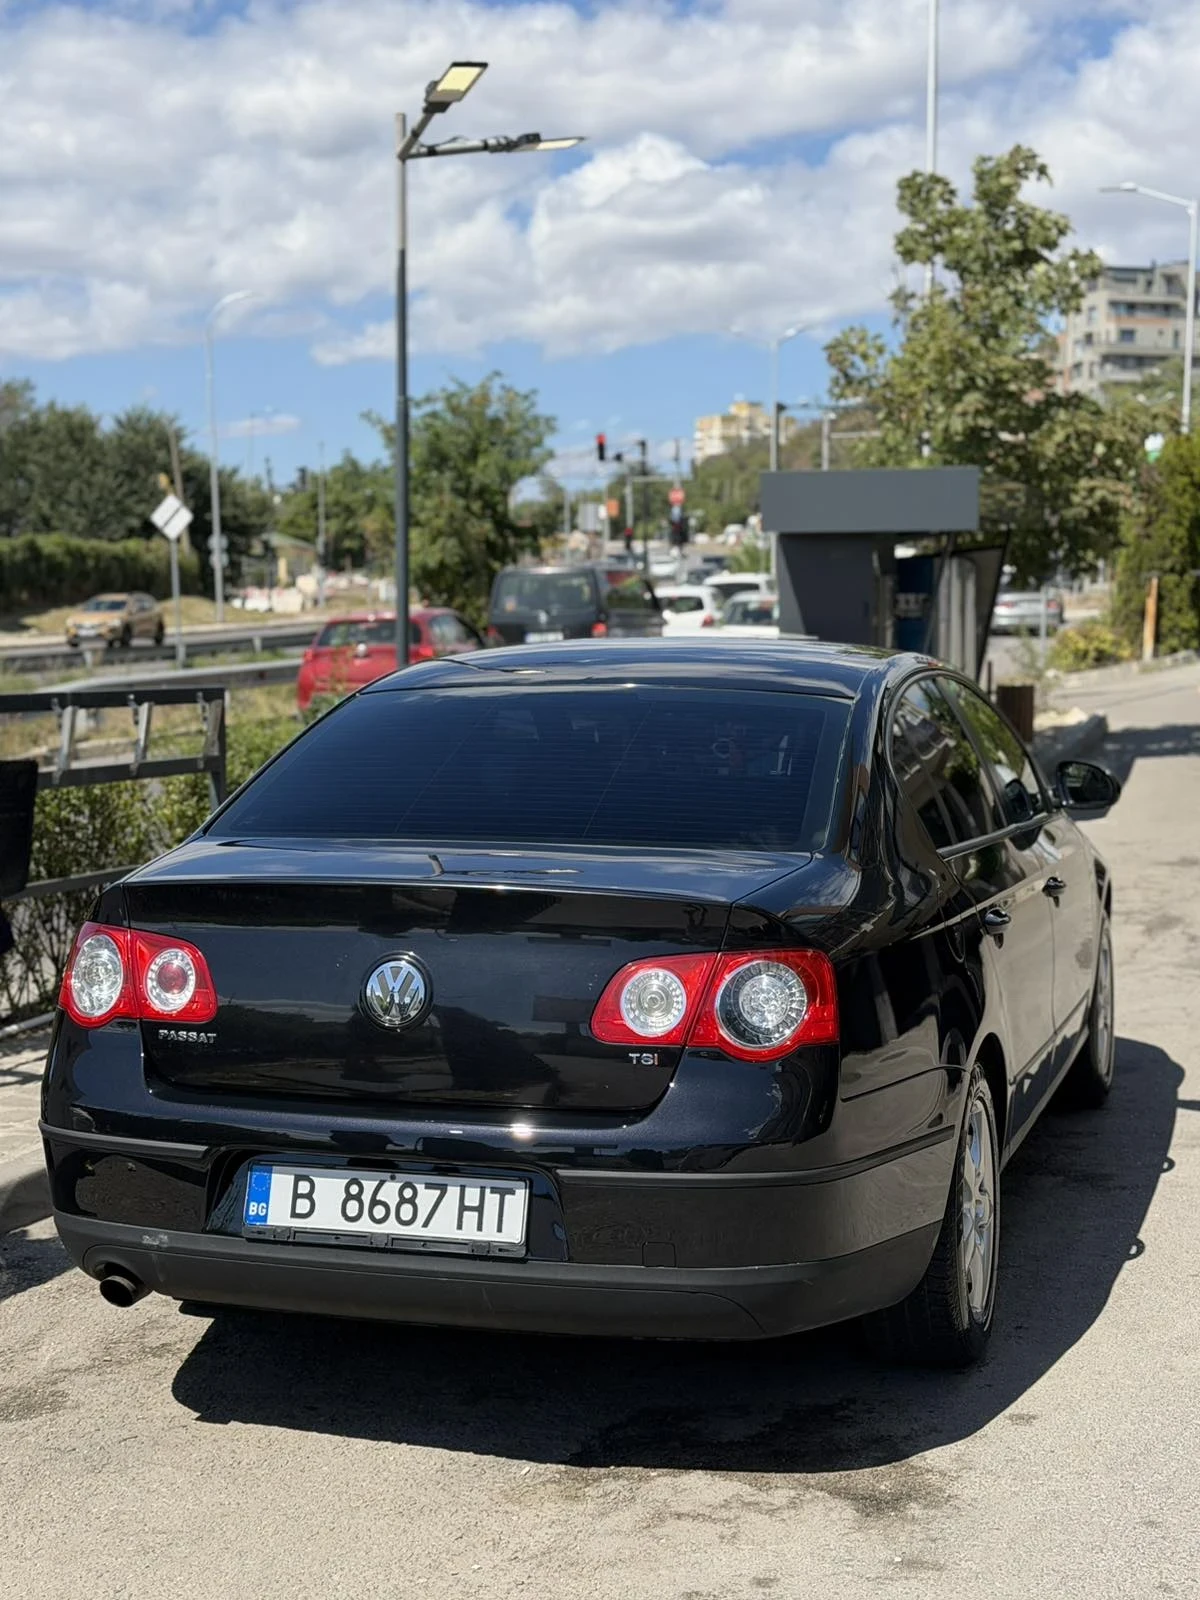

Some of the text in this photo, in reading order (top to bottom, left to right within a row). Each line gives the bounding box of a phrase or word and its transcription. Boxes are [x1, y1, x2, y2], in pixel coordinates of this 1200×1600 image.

[158, 1029, 217, 1044] PASSAT
[628, 1052, 658, 1066] TSI
[289, 1174, 316, 1220] B
[248, 1200, 267, 1217] BG
